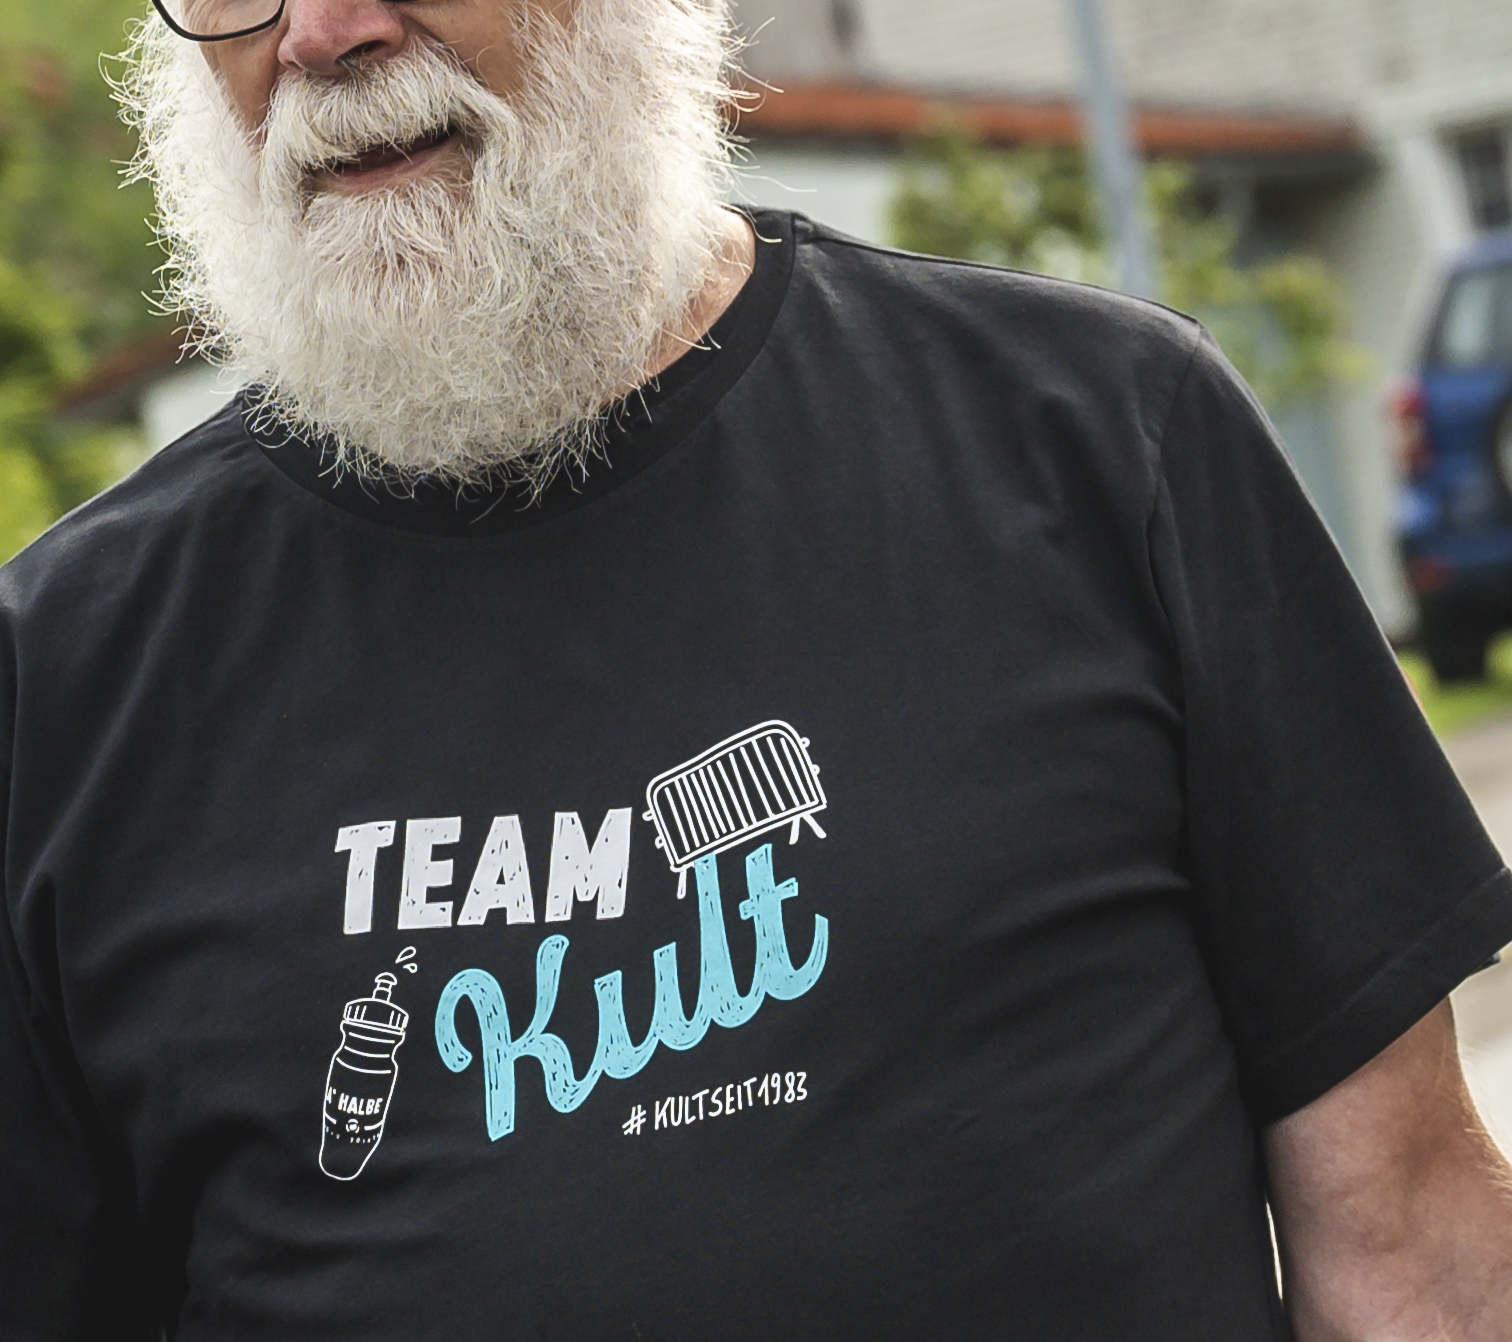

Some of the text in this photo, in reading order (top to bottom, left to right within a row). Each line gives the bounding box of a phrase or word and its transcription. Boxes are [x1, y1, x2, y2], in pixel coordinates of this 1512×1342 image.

[334, 807, 632, 934] TEAM
[434, 842, 829, 1142] Kult
[337, 1092, 384, 1116] HALBE
